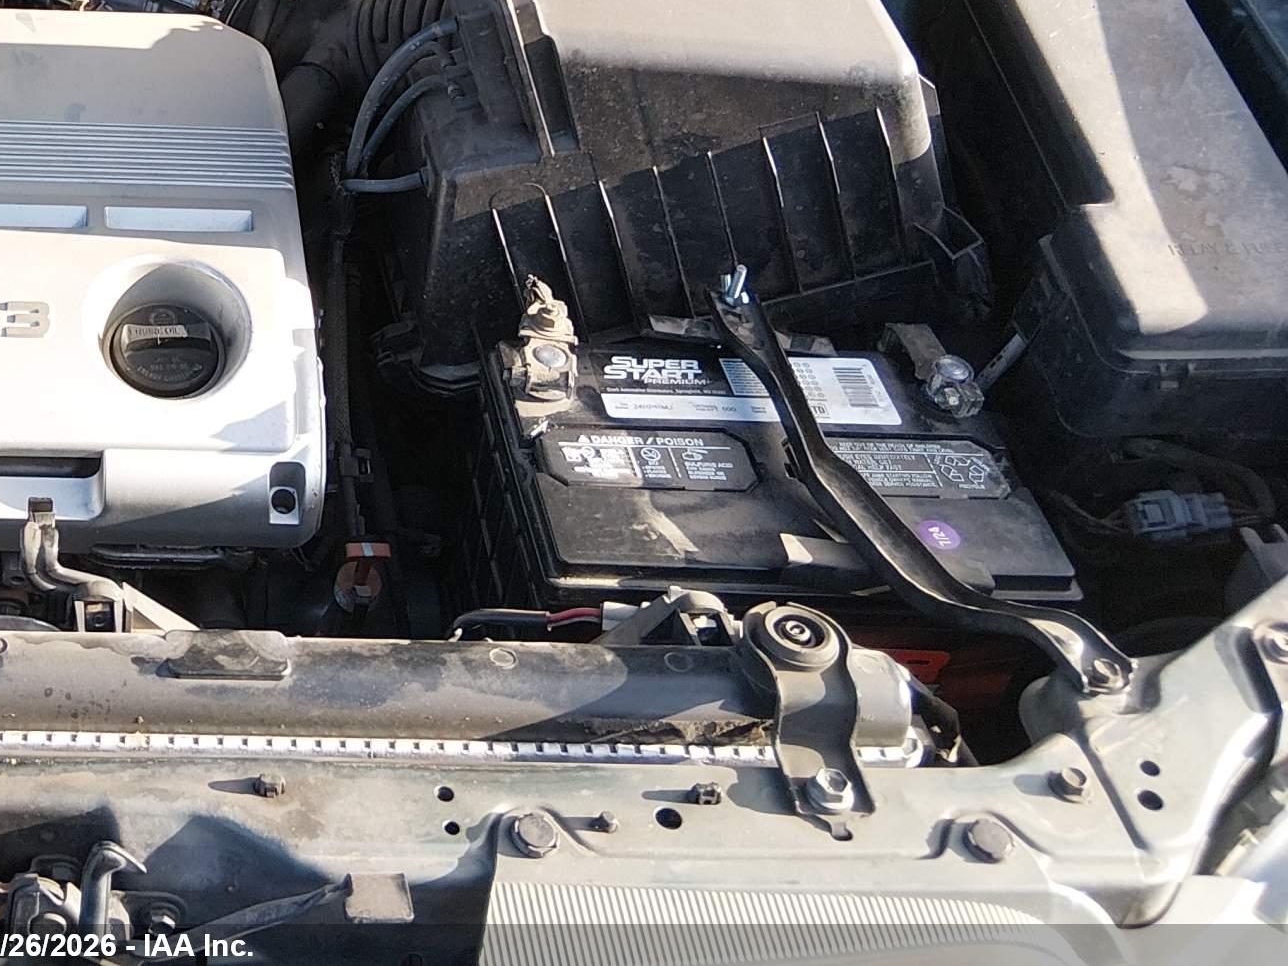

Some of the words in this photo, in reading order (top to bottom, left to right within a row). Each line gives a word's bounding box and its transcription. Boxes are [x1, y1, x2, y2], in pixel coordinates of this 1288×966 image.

[611, 355, 700, 370] SUPER
[603, 365, 703, 380] START
[644, 377, 706, 386] PREMIUM
[590, 435, 643, 446] DANGER
[656, 436, 704, 447] POISON
